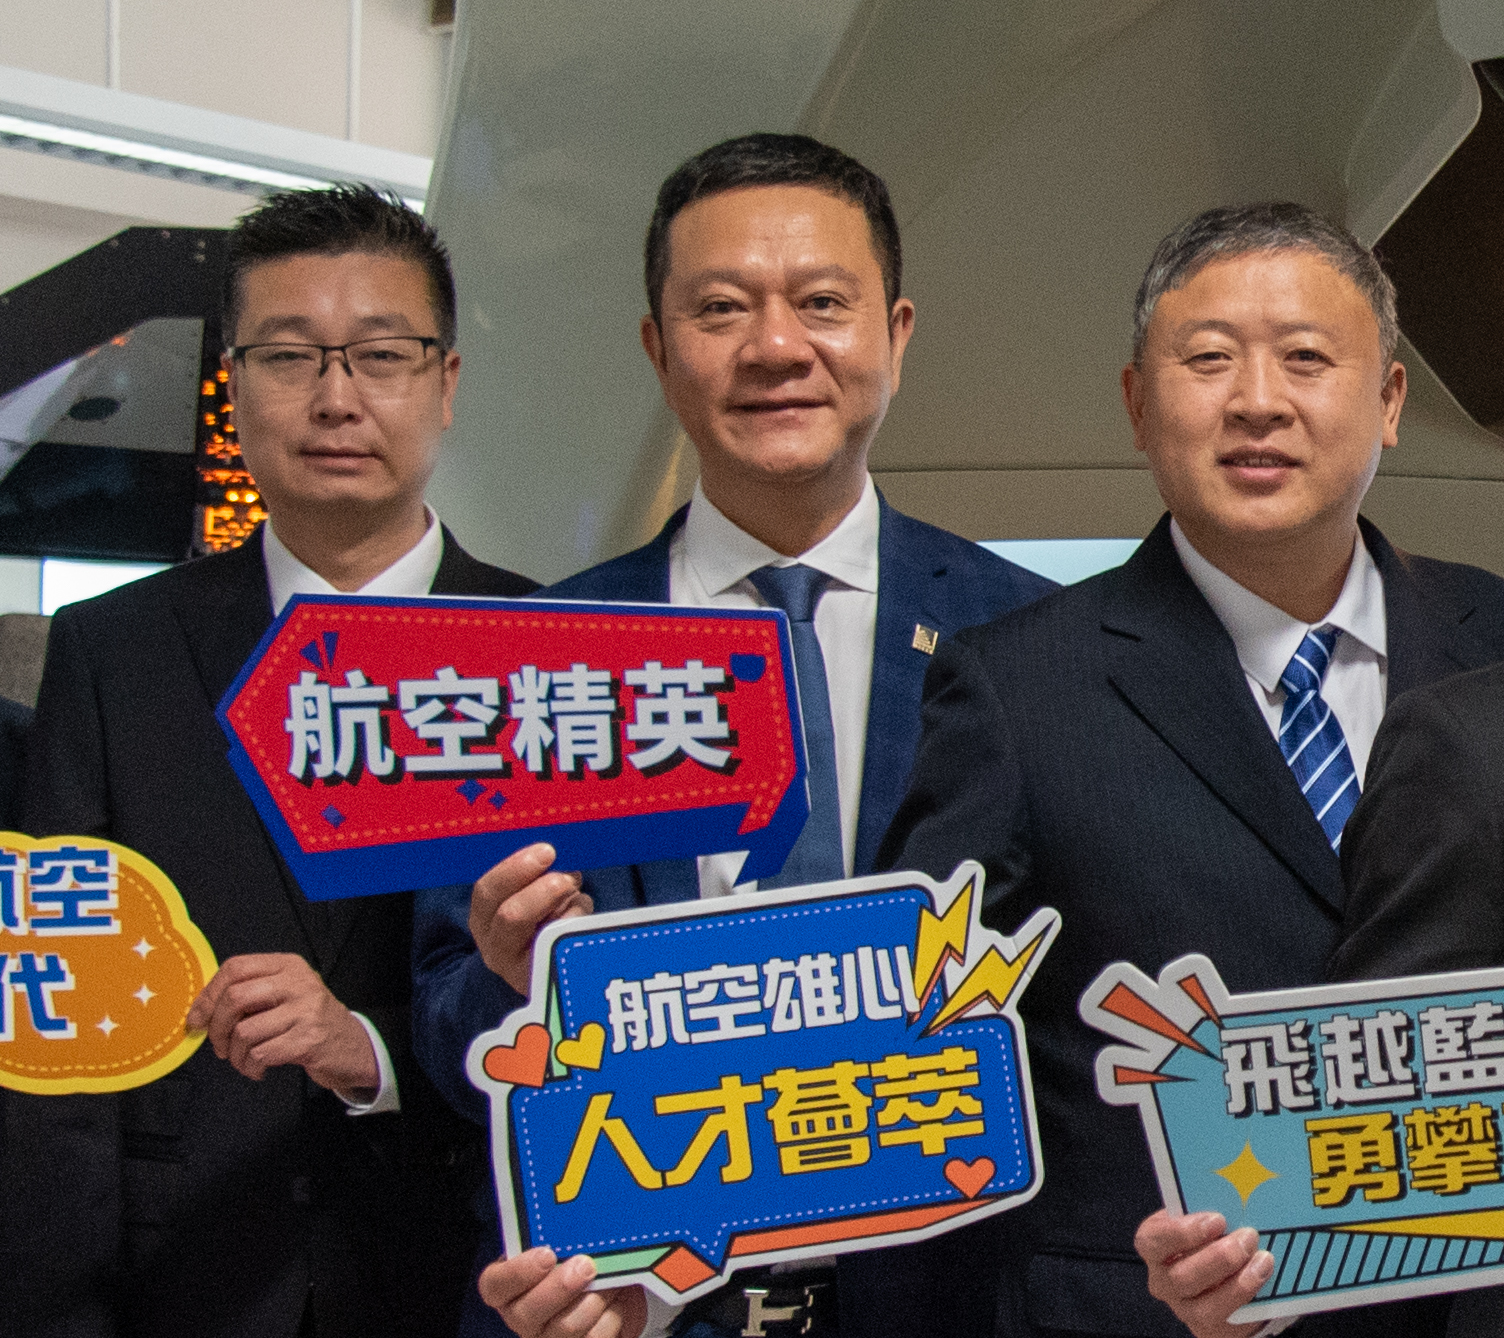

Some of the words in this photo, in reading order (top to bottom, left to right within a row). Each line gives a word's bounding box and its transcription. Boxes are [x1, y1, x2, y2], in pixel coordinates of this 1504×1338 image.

[285, 659, 739, 784] 航空精英
[604, 944, 919, 1053] 航空雄心
[554, 1046, 985, 1204] 人才薈萃
